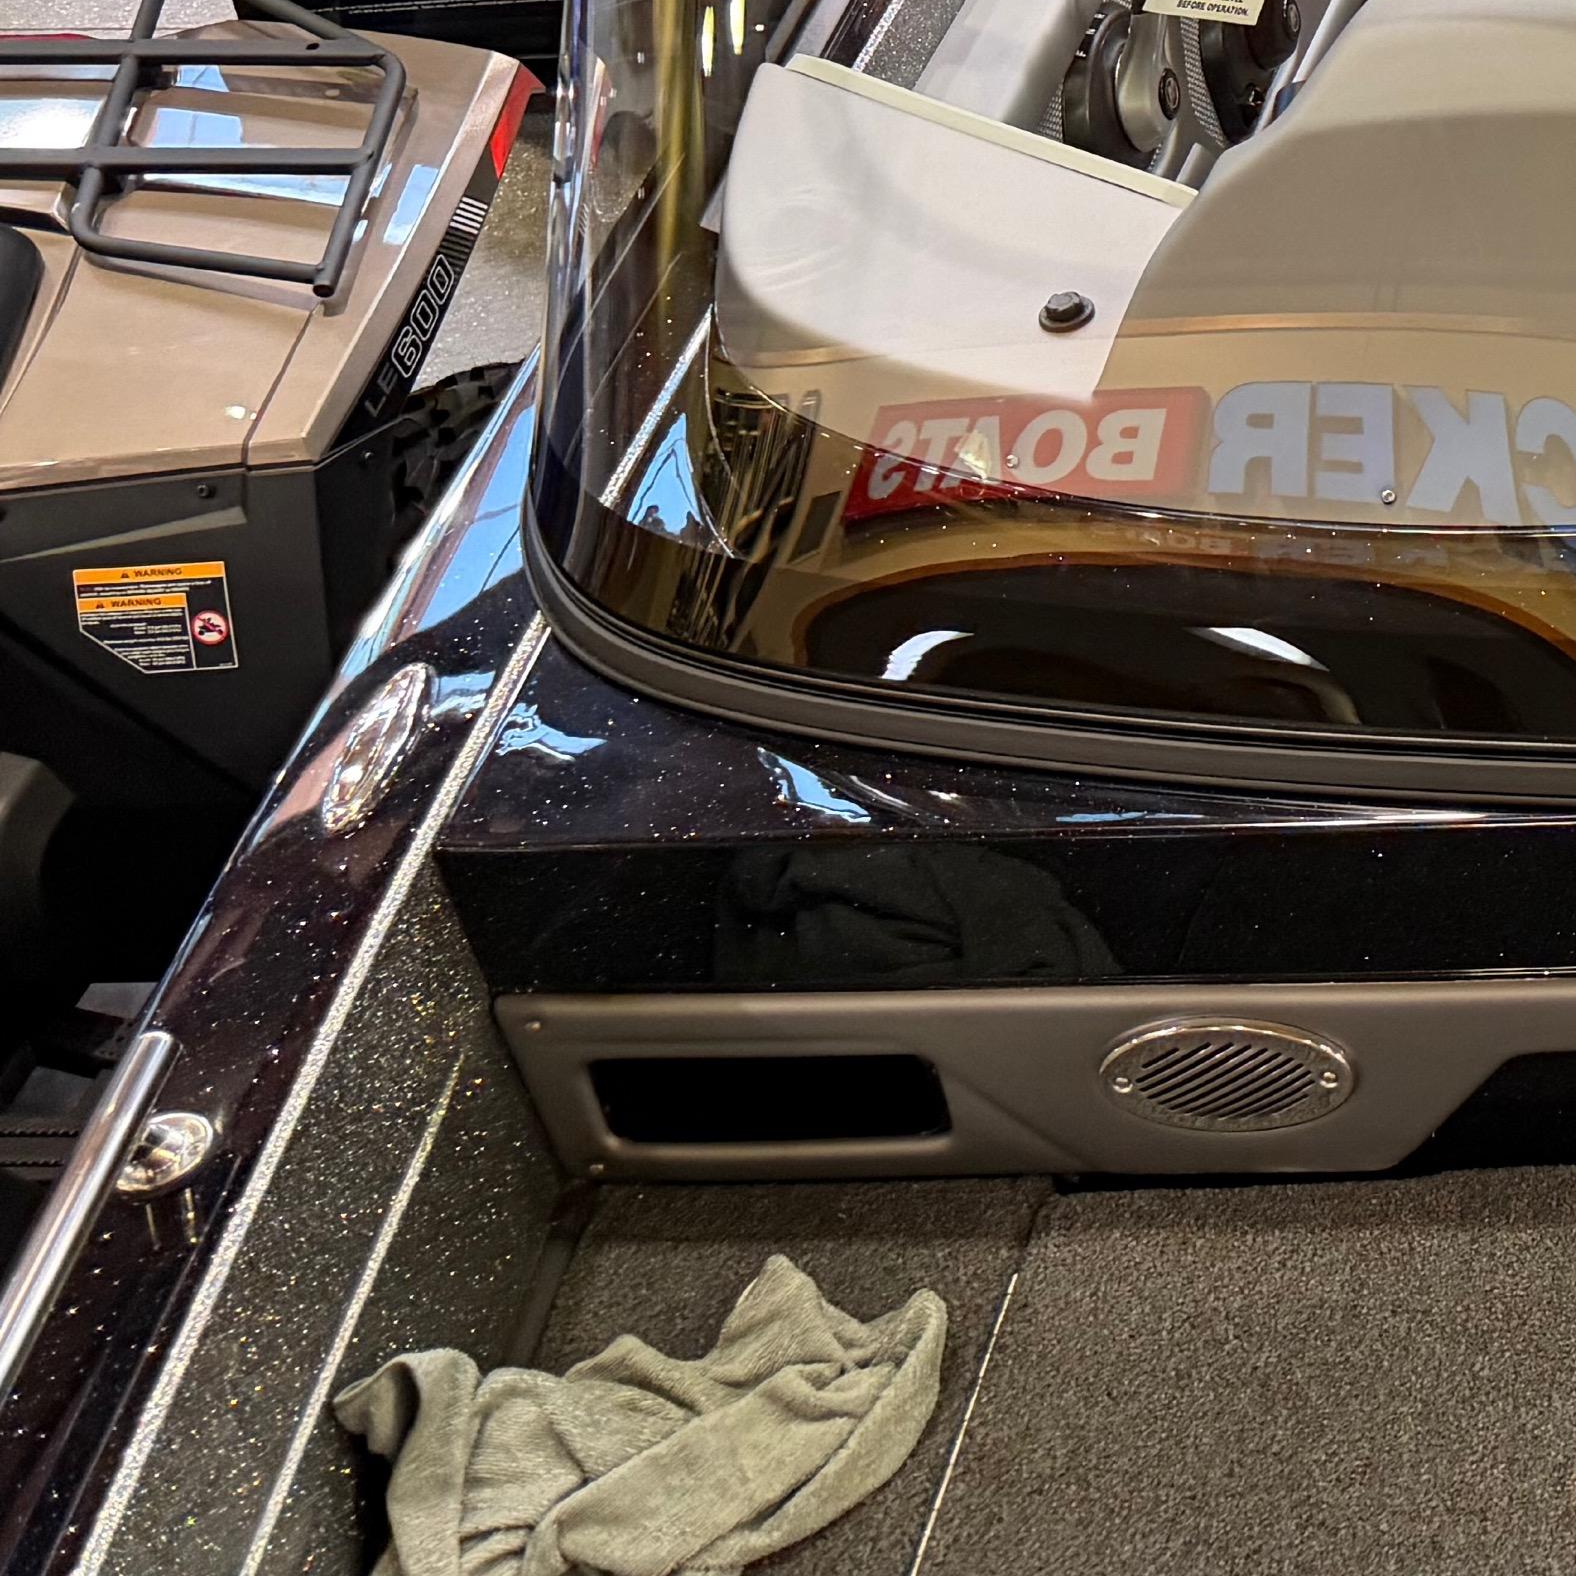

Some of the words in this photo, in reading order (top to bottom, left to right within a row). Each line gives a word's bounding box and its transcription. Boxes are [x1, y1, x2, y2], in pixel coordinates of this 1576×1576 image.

[1177, 0, 1206, 10] BEFORE
[1207, 3, 1249, 16] OPERATION.
[364, 361, 399, 418] LE
[391, 254, 455, 378] 600
[133, 567, 183, 577] WARNING
[111, 597, 162, 607] WARNING
